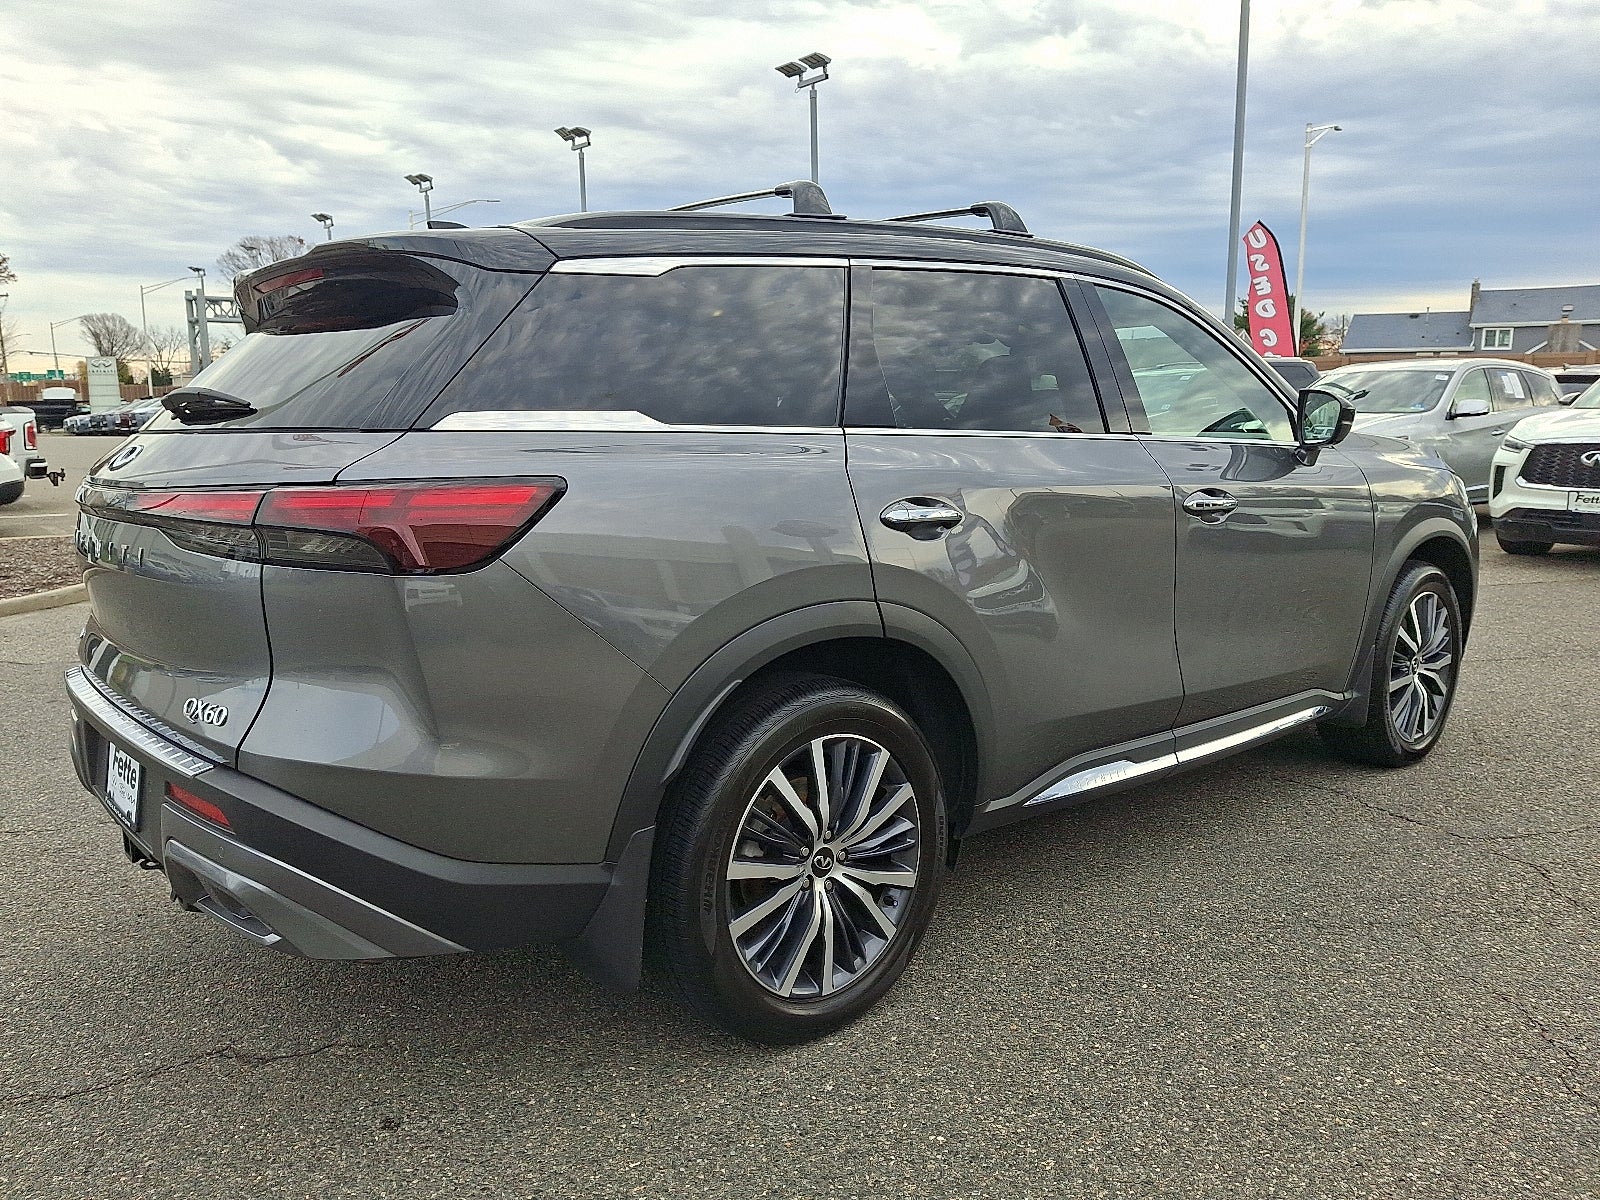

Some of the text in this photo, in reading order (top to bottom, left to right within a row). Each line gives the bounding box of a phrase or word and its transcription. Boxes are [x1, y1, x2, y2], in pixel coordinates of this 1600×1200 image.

[1574, 494, 1600, 504] Fett
[183, 697, 229, 726] QX60
[112, 749, 137, 790] Fette
